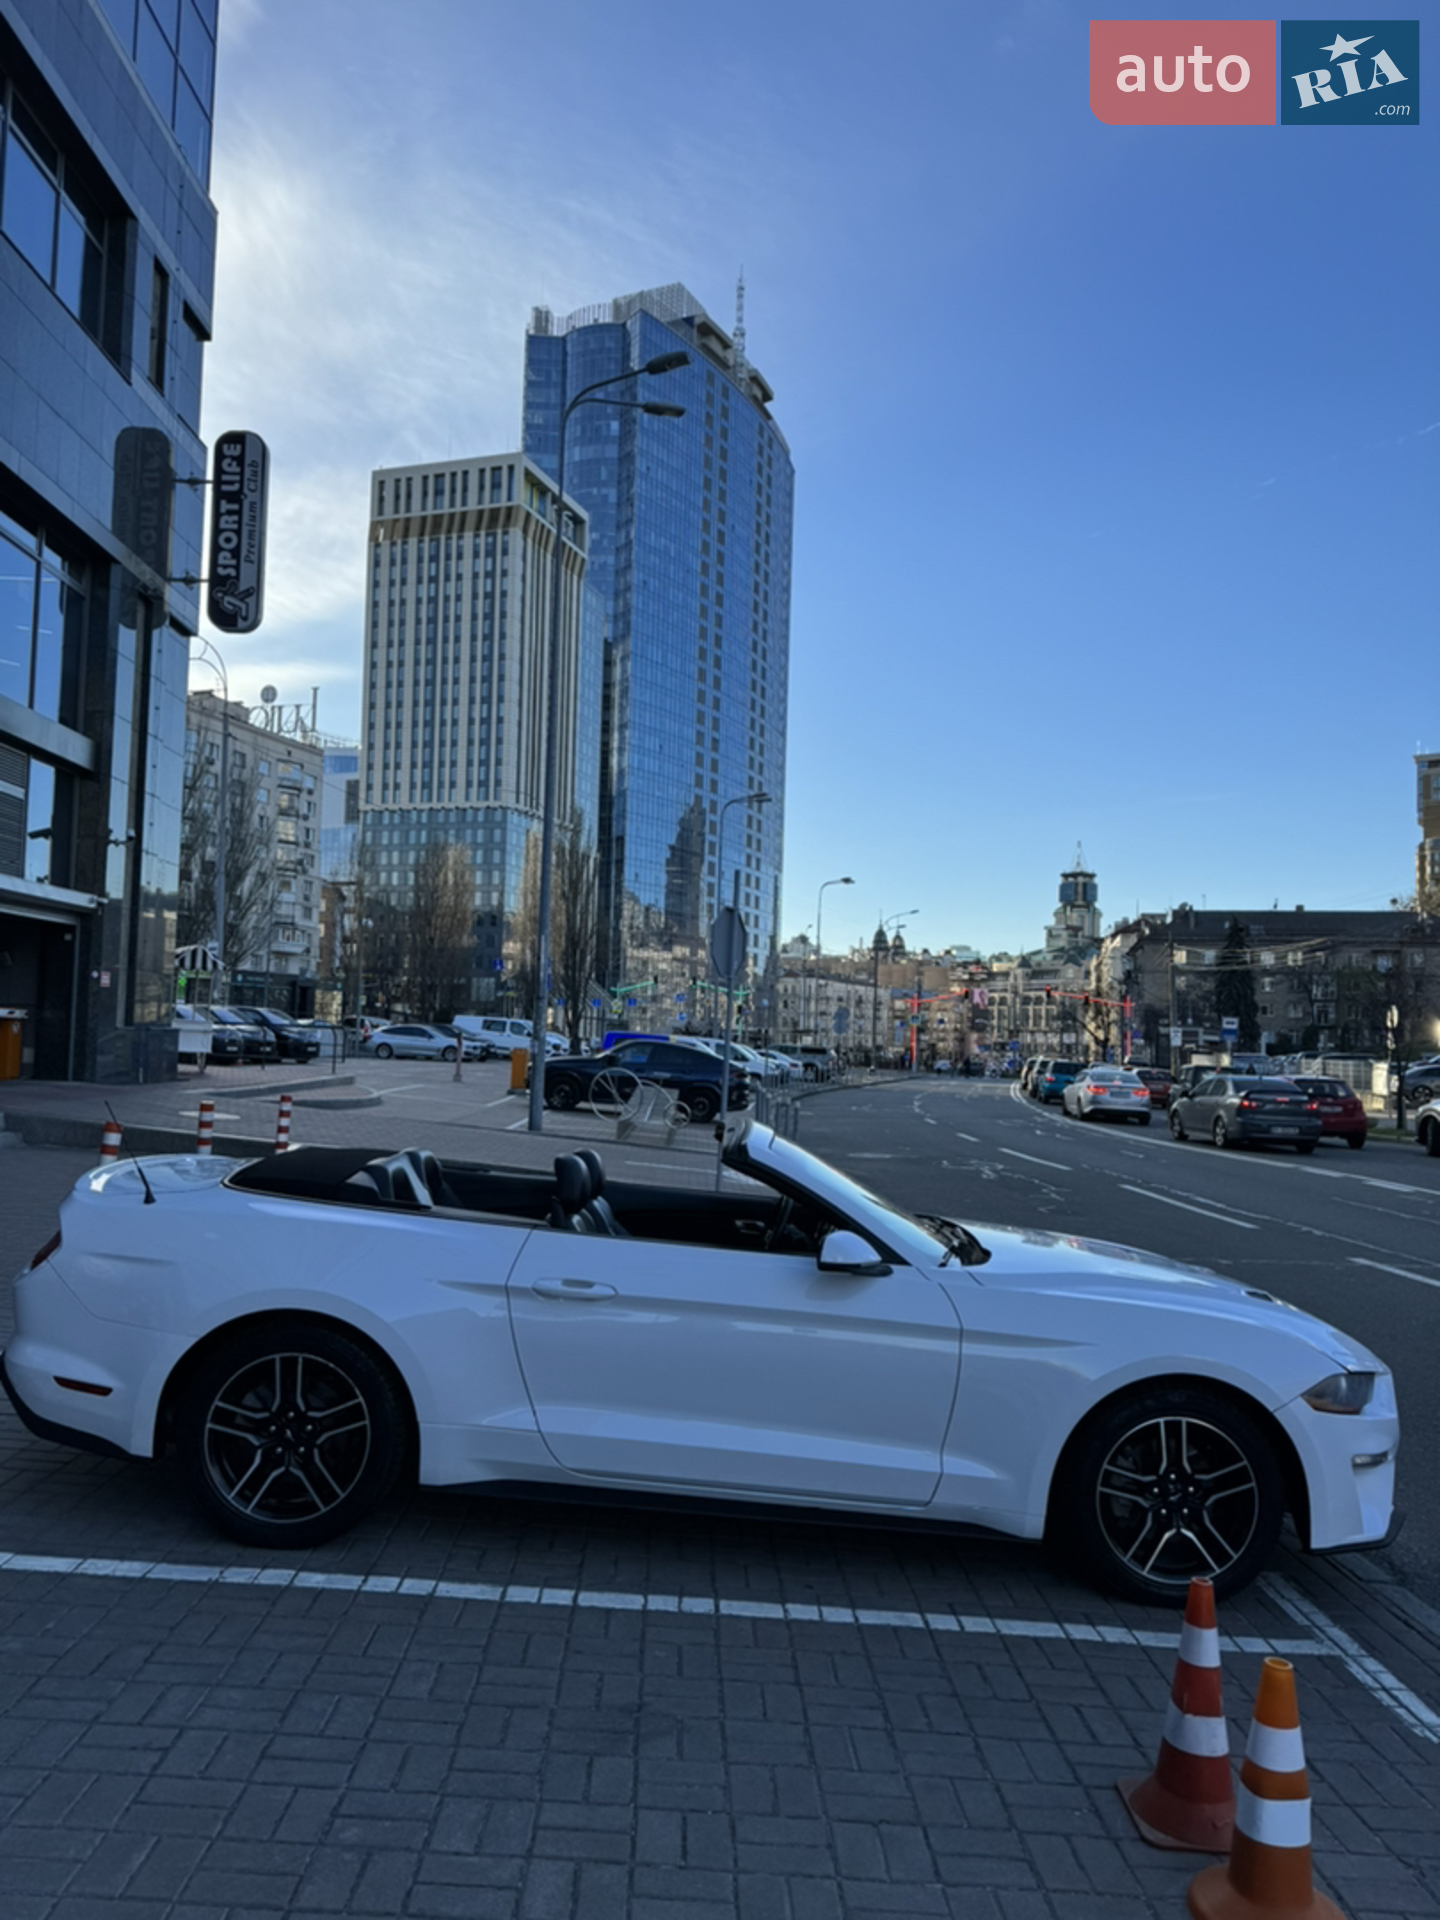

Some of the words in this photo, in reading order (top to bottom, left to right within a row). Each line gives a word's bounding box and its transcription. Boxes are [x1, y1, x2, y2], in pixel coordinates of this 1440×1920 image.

[220, 443, 242, 491] LIFE
[247, 459, 260, 493] Club
[216, 500, 240, 577] SPORT
[243, 501, 258, 565] Premium
